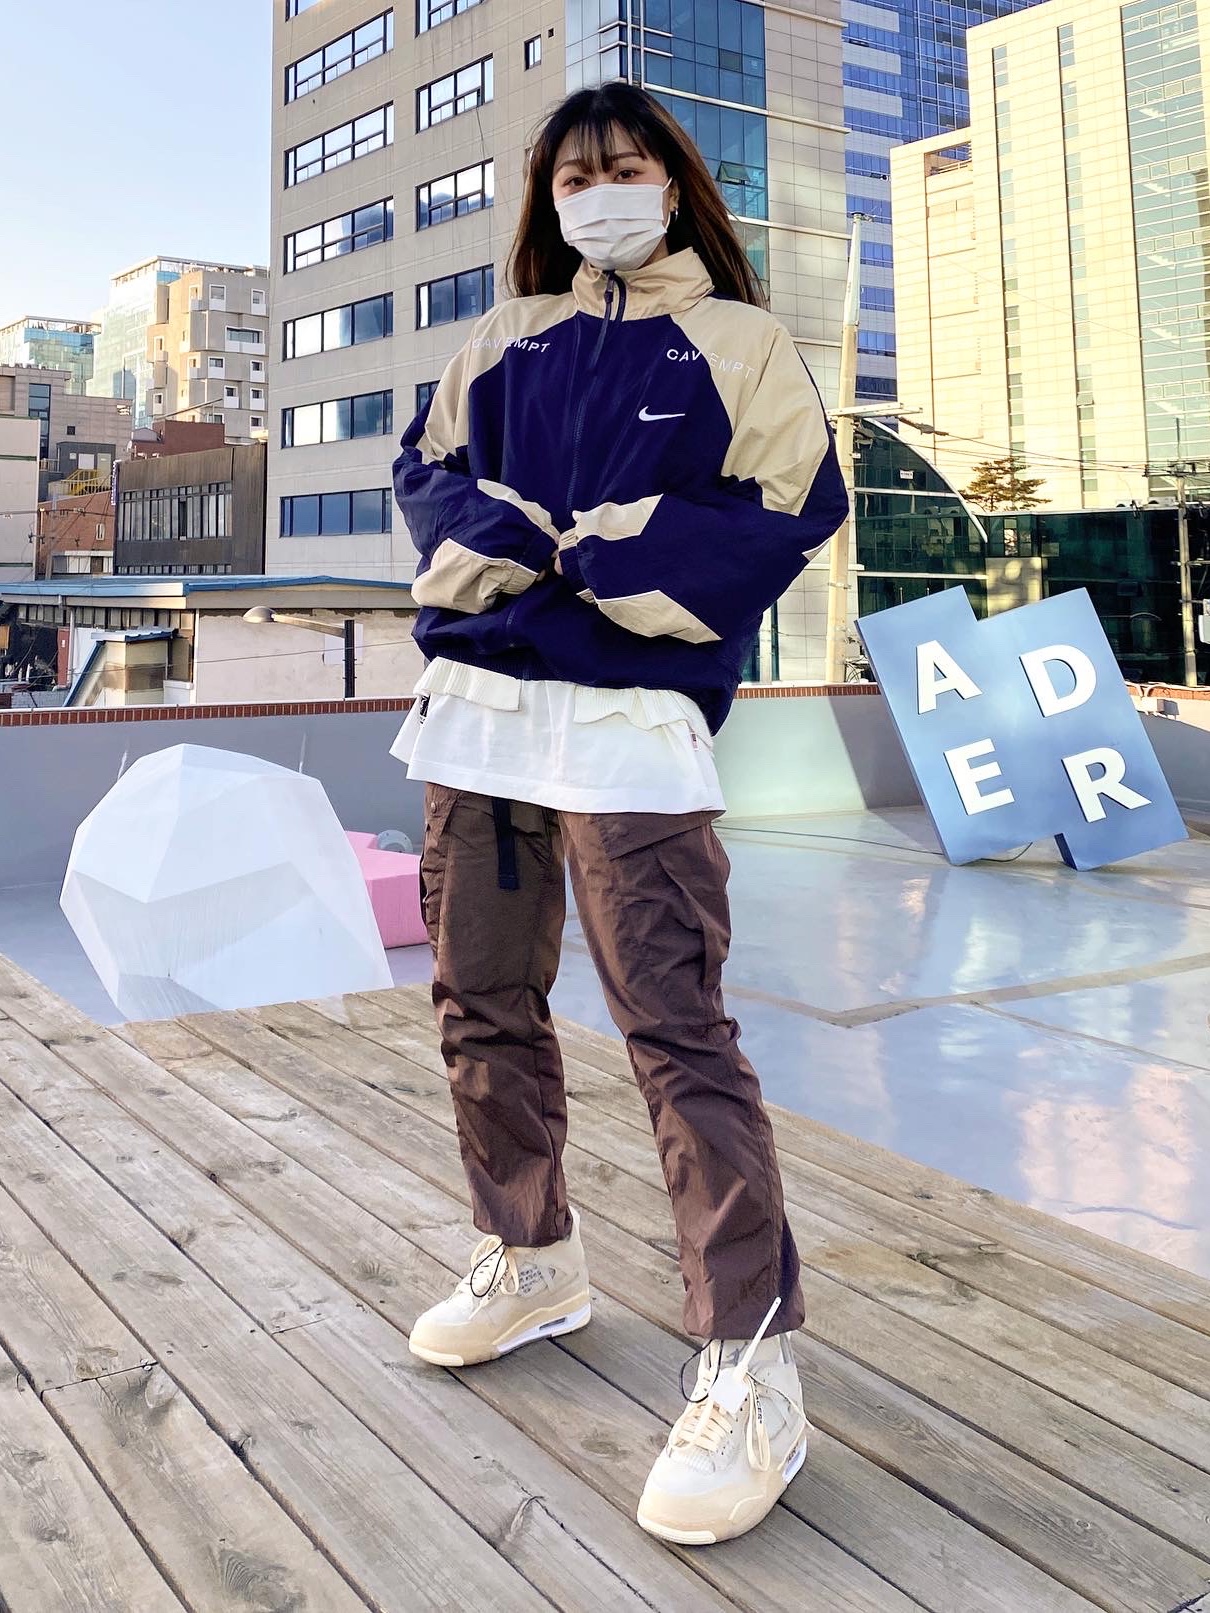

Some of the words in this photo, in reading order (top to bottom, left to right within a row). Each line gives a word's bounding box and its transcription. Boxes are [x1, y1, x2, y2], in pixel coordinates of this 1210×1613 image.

[504, 337, 551, 353] EMPT
[666, 348, 701, 362] CAV
[709, 352, 755, 379] EMPT
